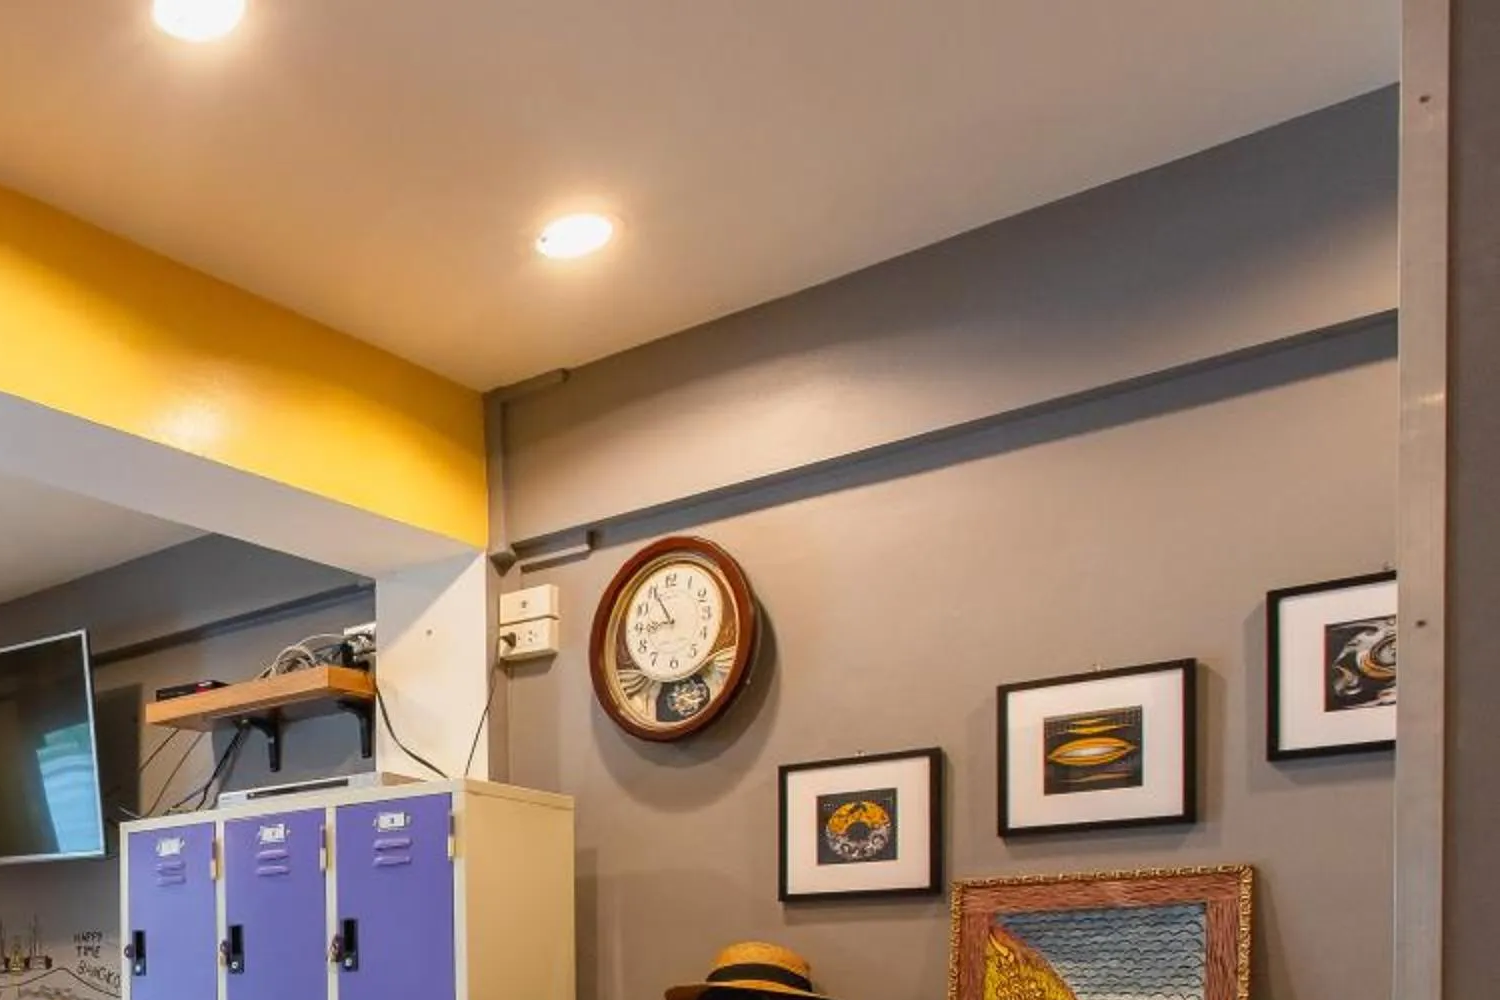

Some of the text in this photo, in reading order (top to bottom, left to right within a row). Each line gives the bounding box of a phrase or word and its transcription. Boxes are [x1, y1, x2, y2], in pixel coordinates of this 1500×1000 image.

[665, 573, 677, 588] 12
[697, 587, 707, 602] 2
[637, 603, 649, 616] 10
[702, 605, 712, 620] 3
[635, 622, 644, 634] 9
[699, 626, 708, 640] 4
[638, 640, 647, 653] 8
[689, 643, 697, 659] 5
[650, 651, 658, 667] 7
[669, 655, 679, 669] 6
[76, 945, 100, 958] TIME
